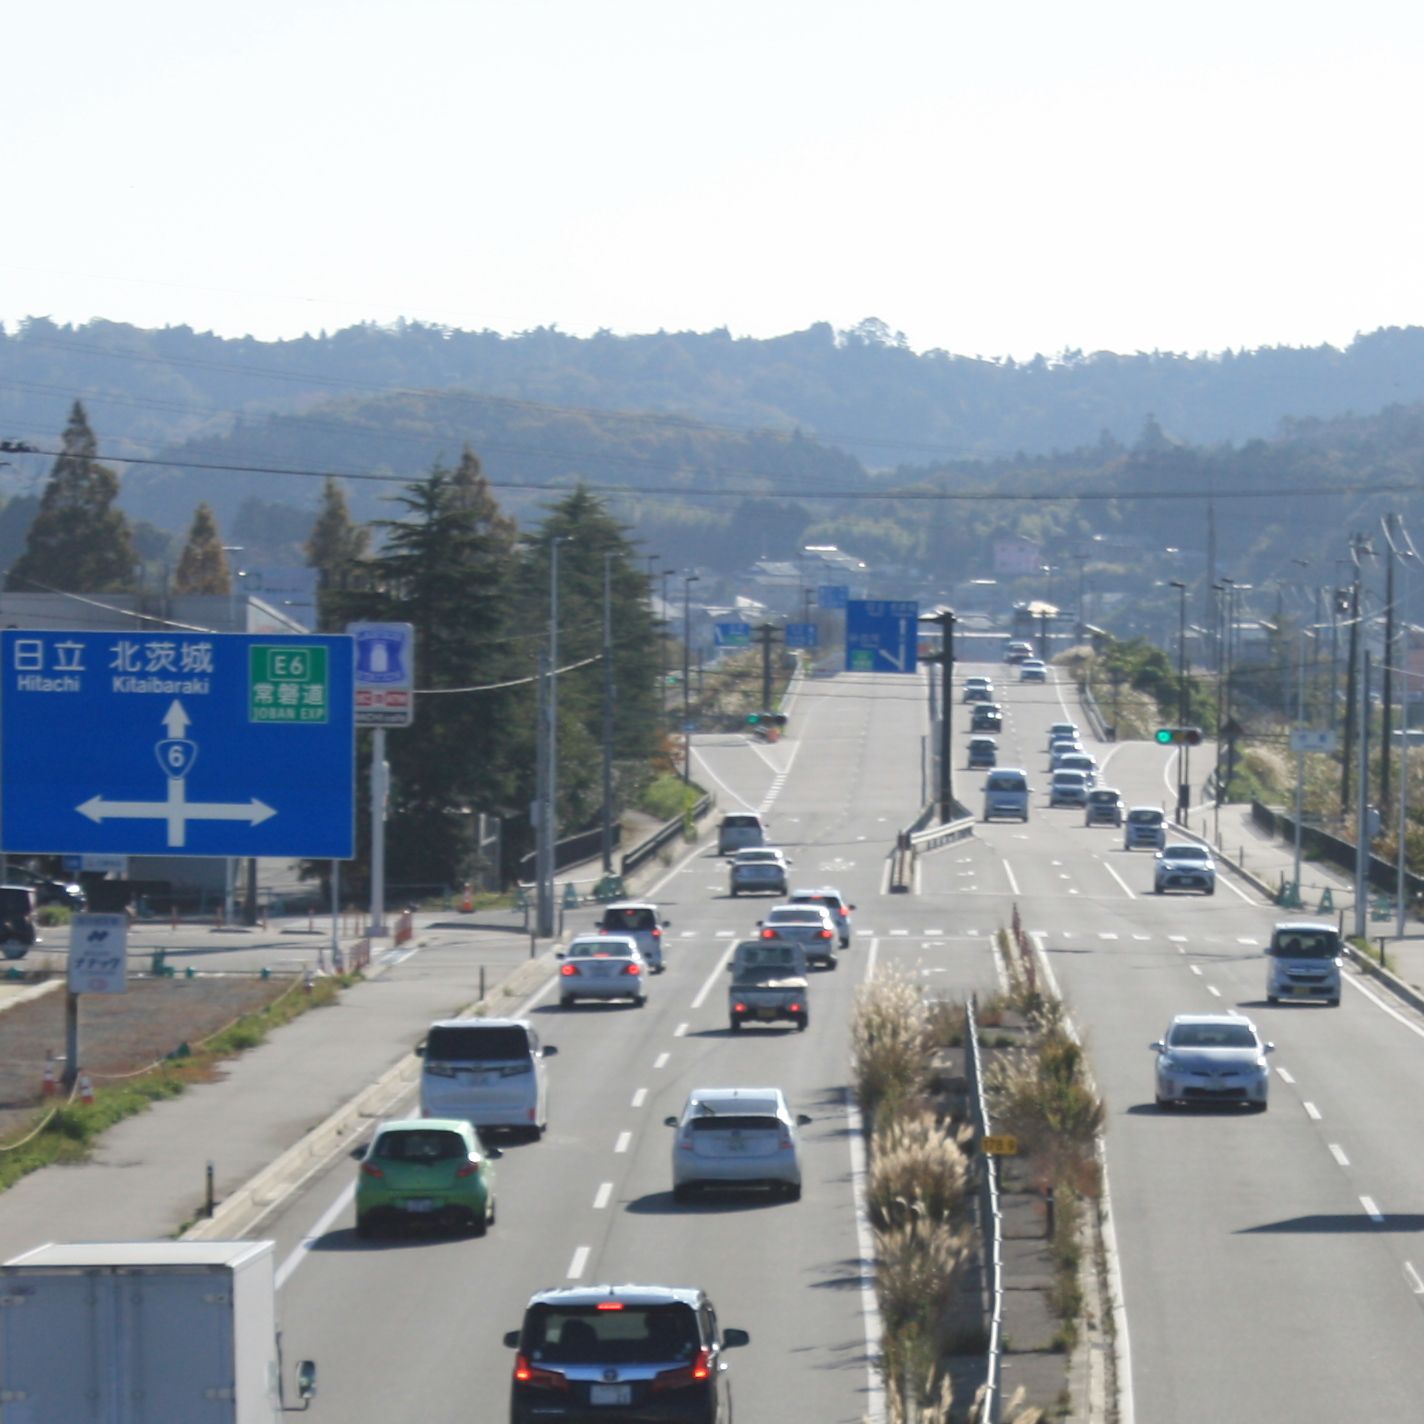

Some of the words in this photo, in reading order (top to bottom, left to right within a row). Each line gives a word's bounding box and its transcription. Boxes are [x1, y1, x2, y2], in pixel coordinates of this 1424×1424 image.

[14, 639, 86, 671] 日立
[108, 640, 214, 673] 北茨城
[274, 655, 305, 675] E6
[17, 674, 81, 692] Hitachi
[112, 676, 210, 695] Kitaibaraki
[168, 744, 184, 768] 6
